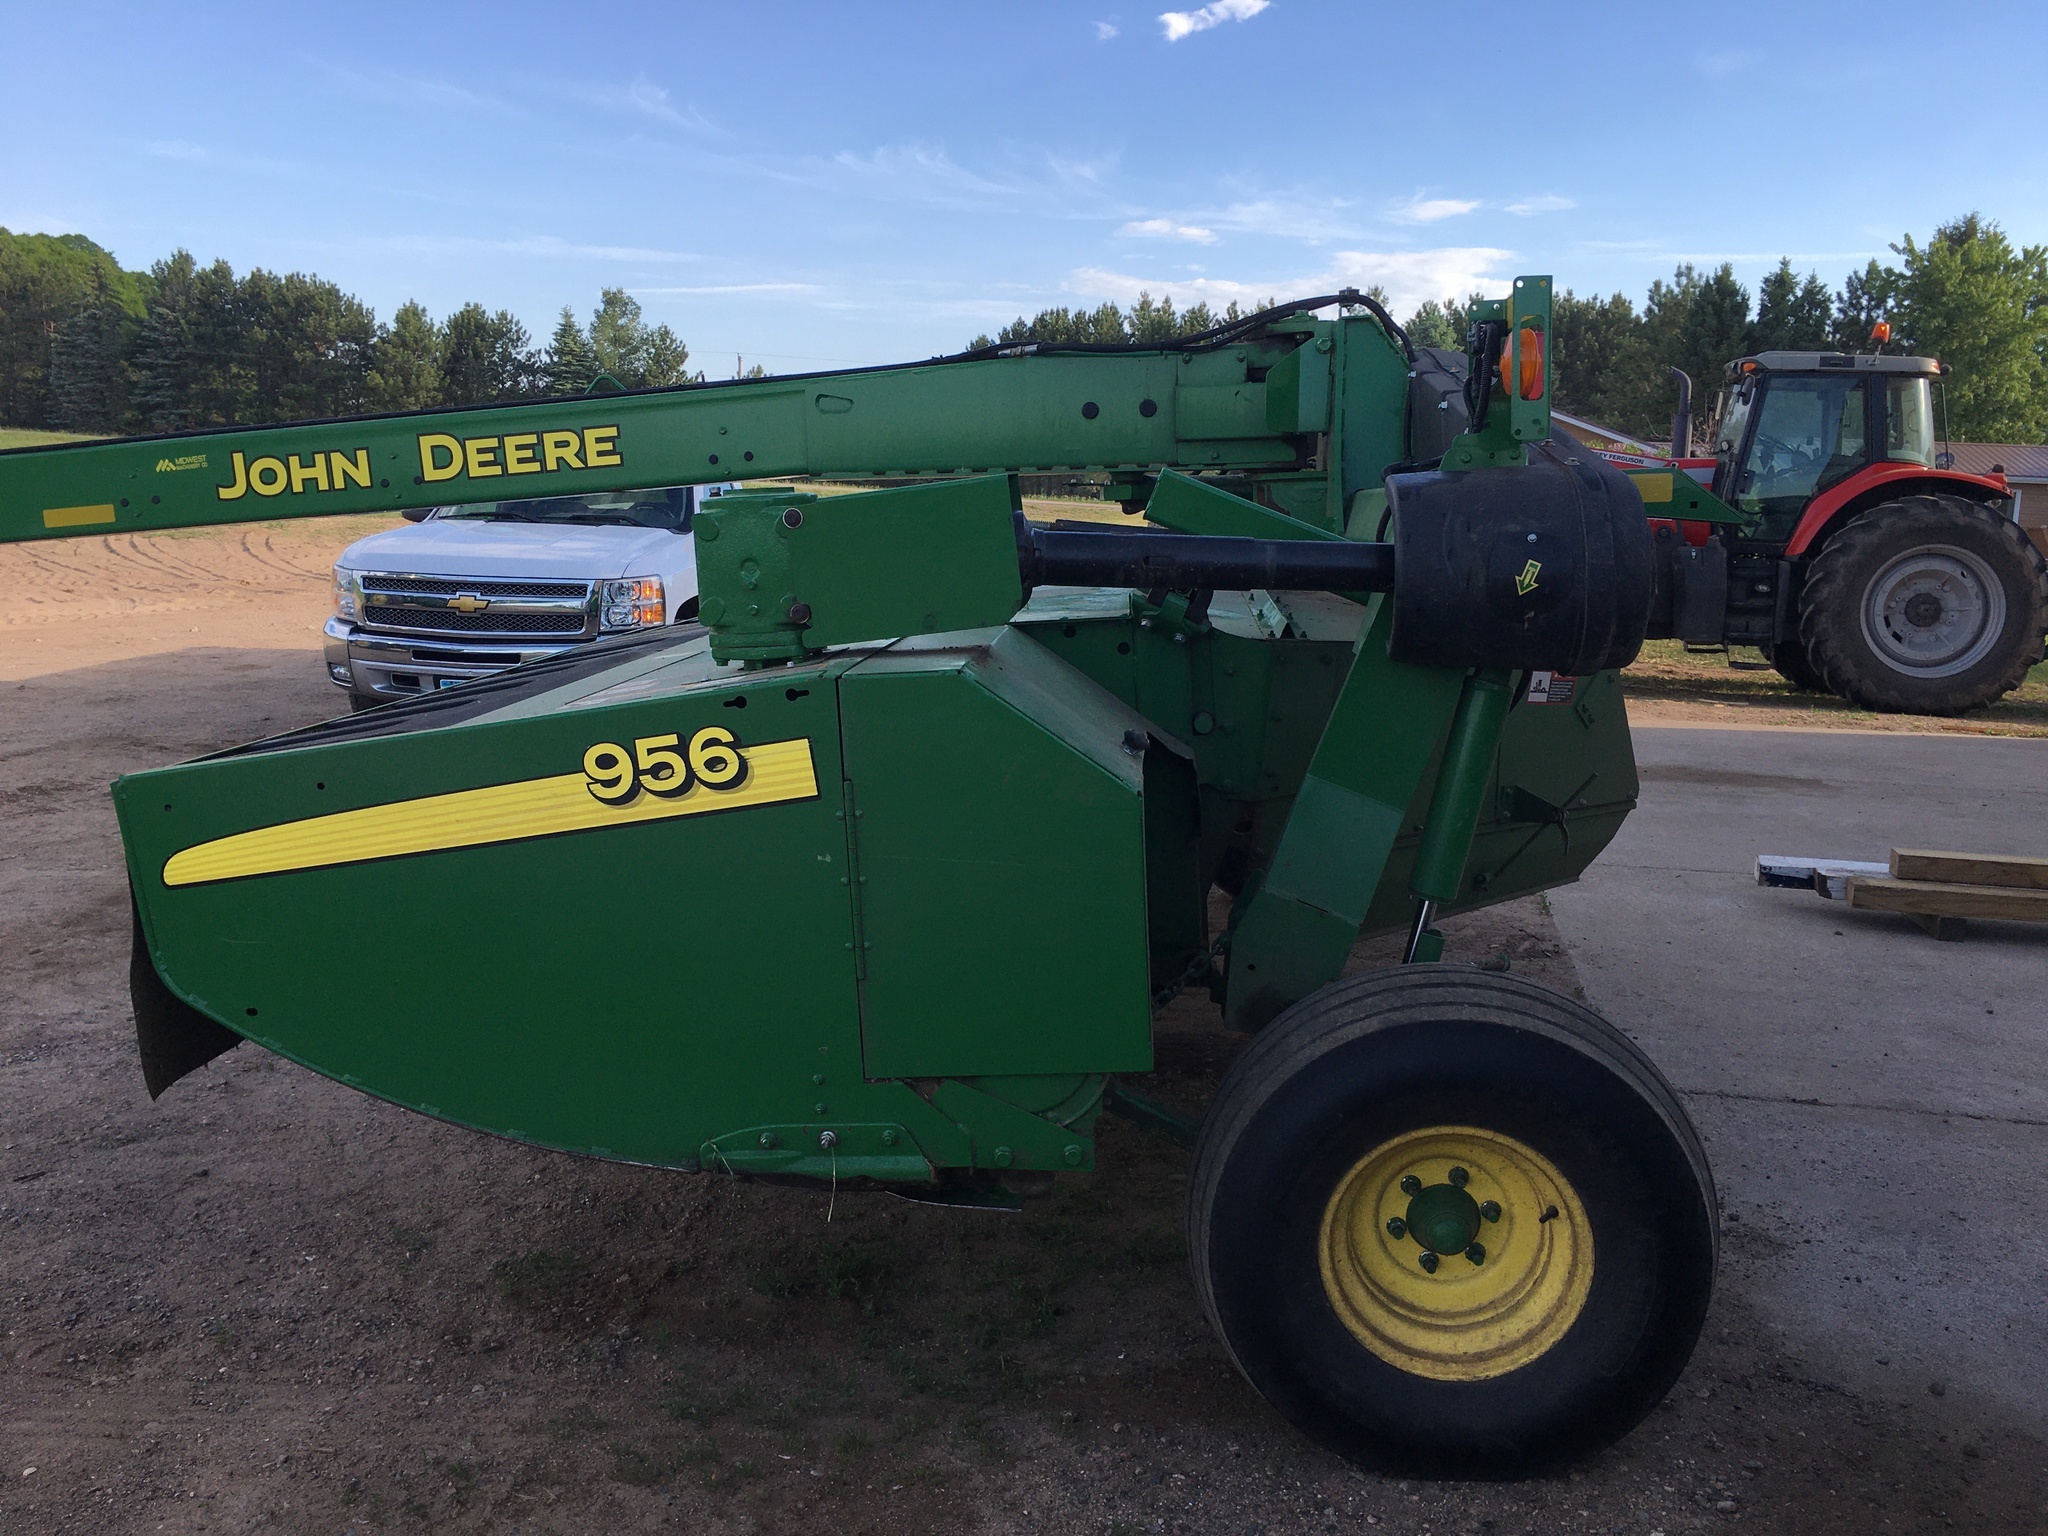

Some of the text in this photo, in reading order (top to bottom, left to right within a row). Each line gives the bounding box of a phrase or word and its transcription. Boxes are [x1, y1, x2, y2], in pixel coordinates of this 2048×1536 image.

[175, 454, 206, 464] MIDWEST
[217, 424, 623, 499] JOHN DEERE
[1609, 454, 1644, 465] FERGUSON
[583, 725, 748, 805] 956
